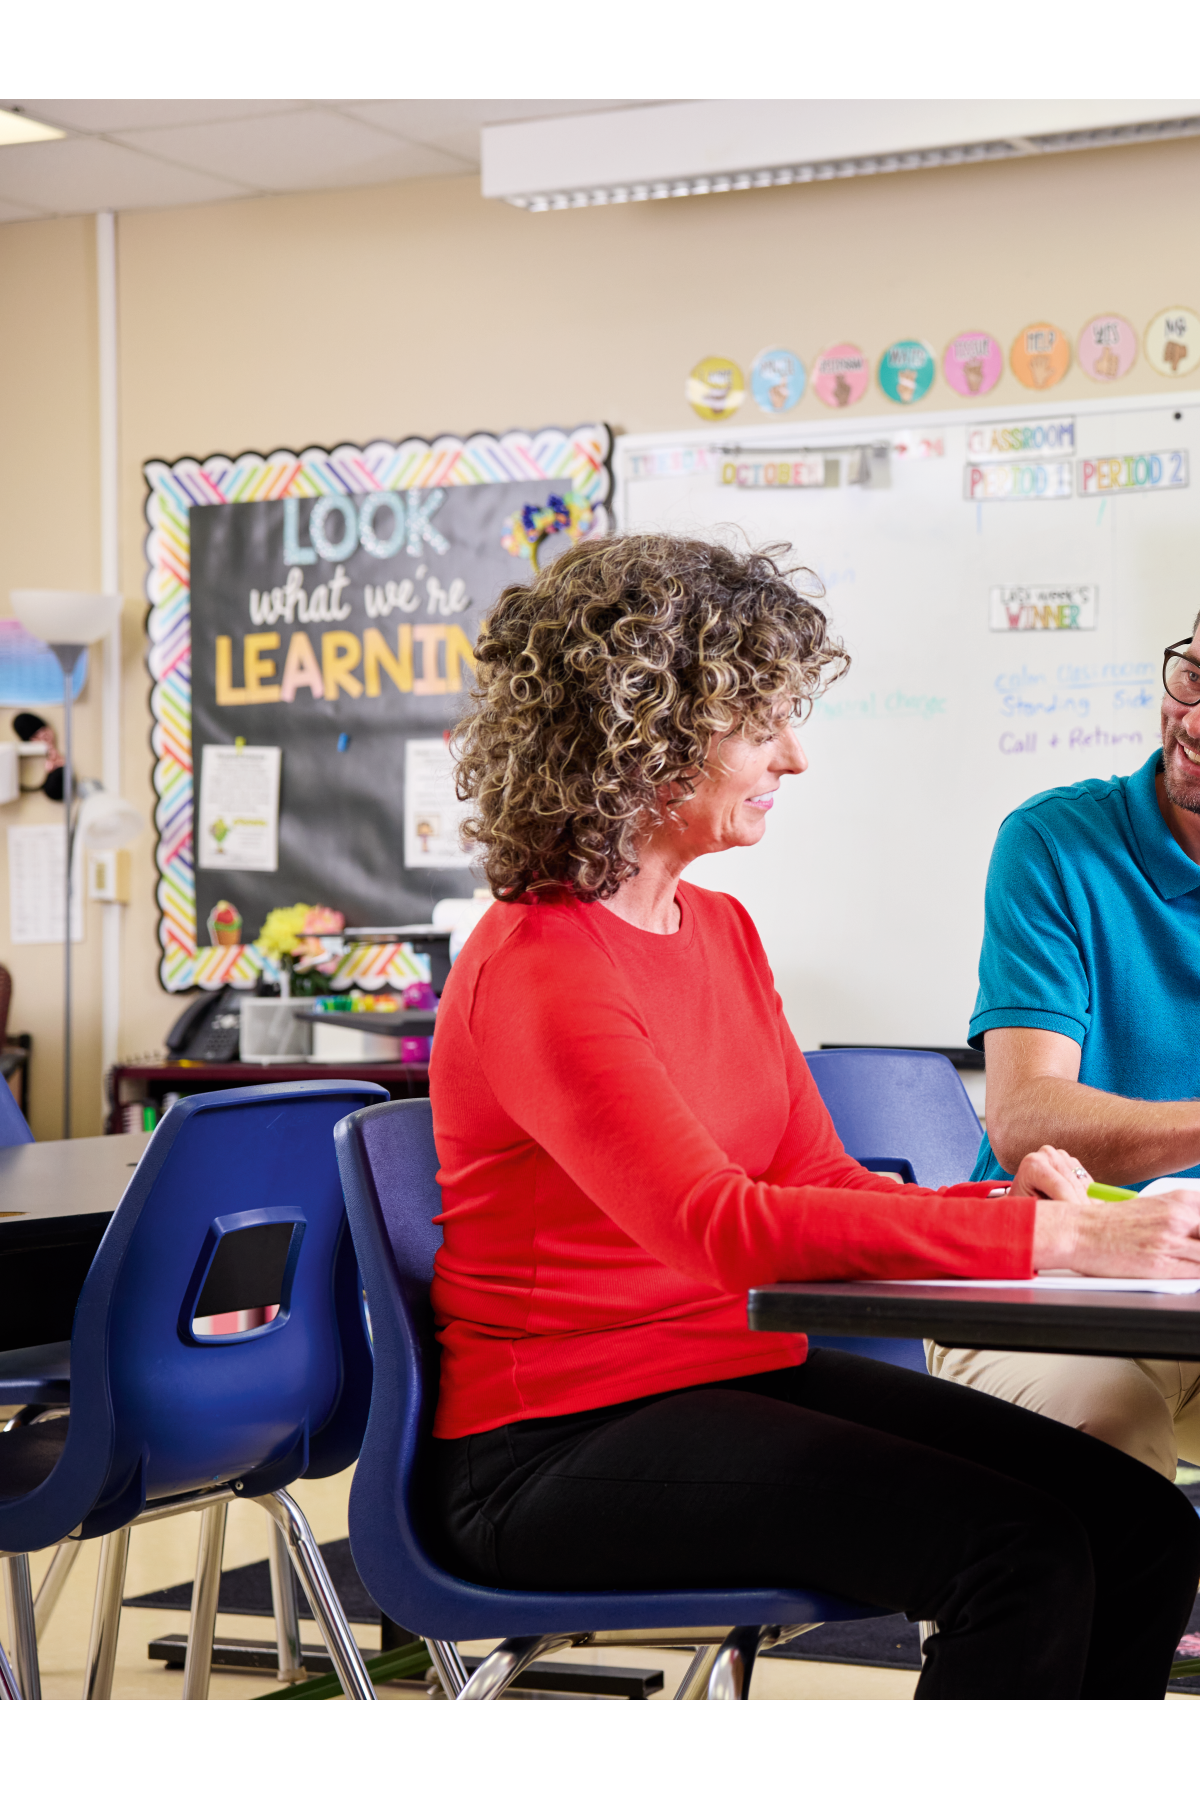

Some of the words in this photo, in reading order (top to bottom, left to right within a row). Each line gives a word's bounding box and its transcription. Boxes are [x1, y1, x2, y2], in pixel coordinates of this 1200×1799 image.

[968, 423, 1075, 454] CLASSROOM
[722, 460, 823, 486] OCTOBER
[970, 466, 1048, 496] PERIOD
[1083, 456, 1163, 491] PERIOD
[1170, 454, 1183, 484] 2
[283, 488, 450, 566] LOOK
[250, 565, 351, 626] what
[364, 564, 470, 618] we're
[1006, 604, 1080, 630] WINNER
[215, 622, 488, 706] LEARNIN
